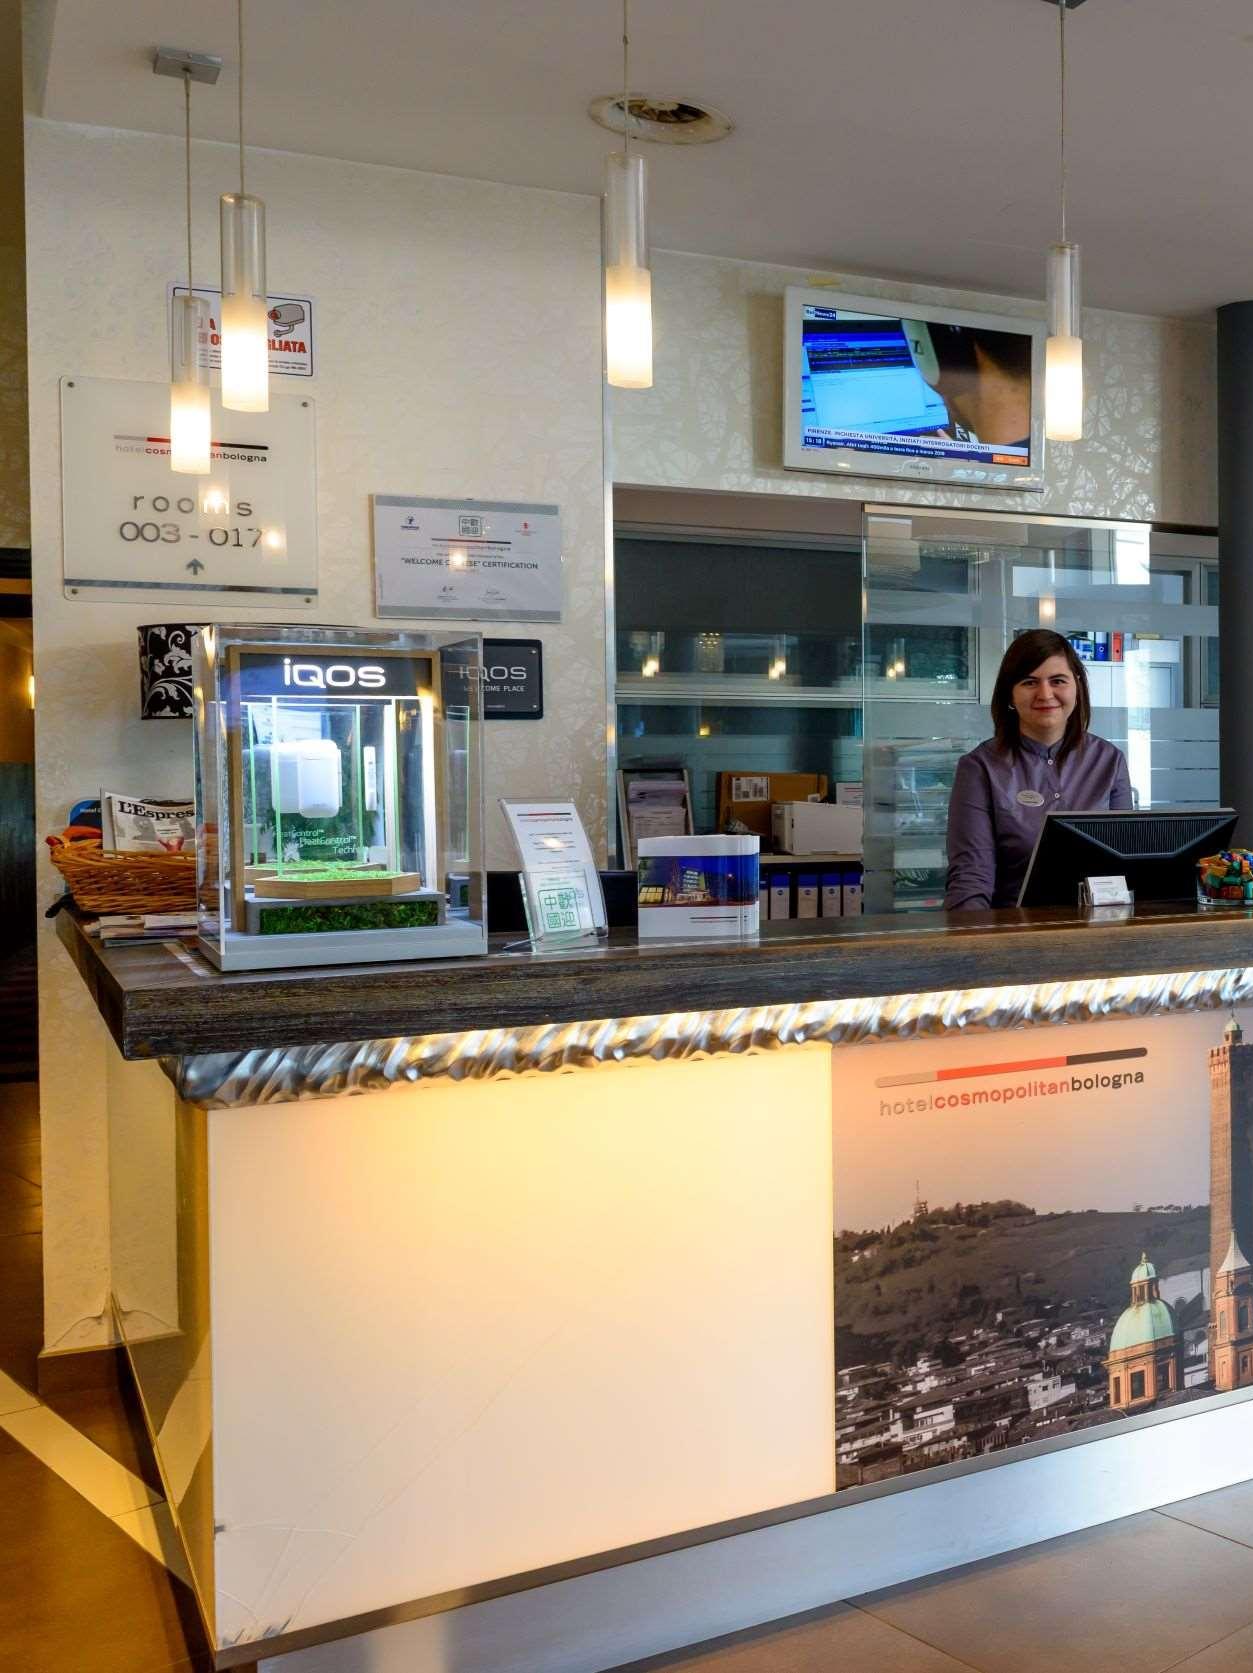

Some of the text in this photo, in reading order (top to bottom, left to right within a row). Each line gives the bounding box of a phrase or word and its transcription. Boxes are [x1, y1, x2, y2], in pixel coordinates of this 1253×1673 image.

[119, 521, 182, 544] 003
[208, 527, 264, 548] 017
[482, 560, 539, 569] CERTIFICATION
[117, 800, 195, 821] L'Espres
[879, 1069, 1146, 1117] hotelcosmopolitanbologna
